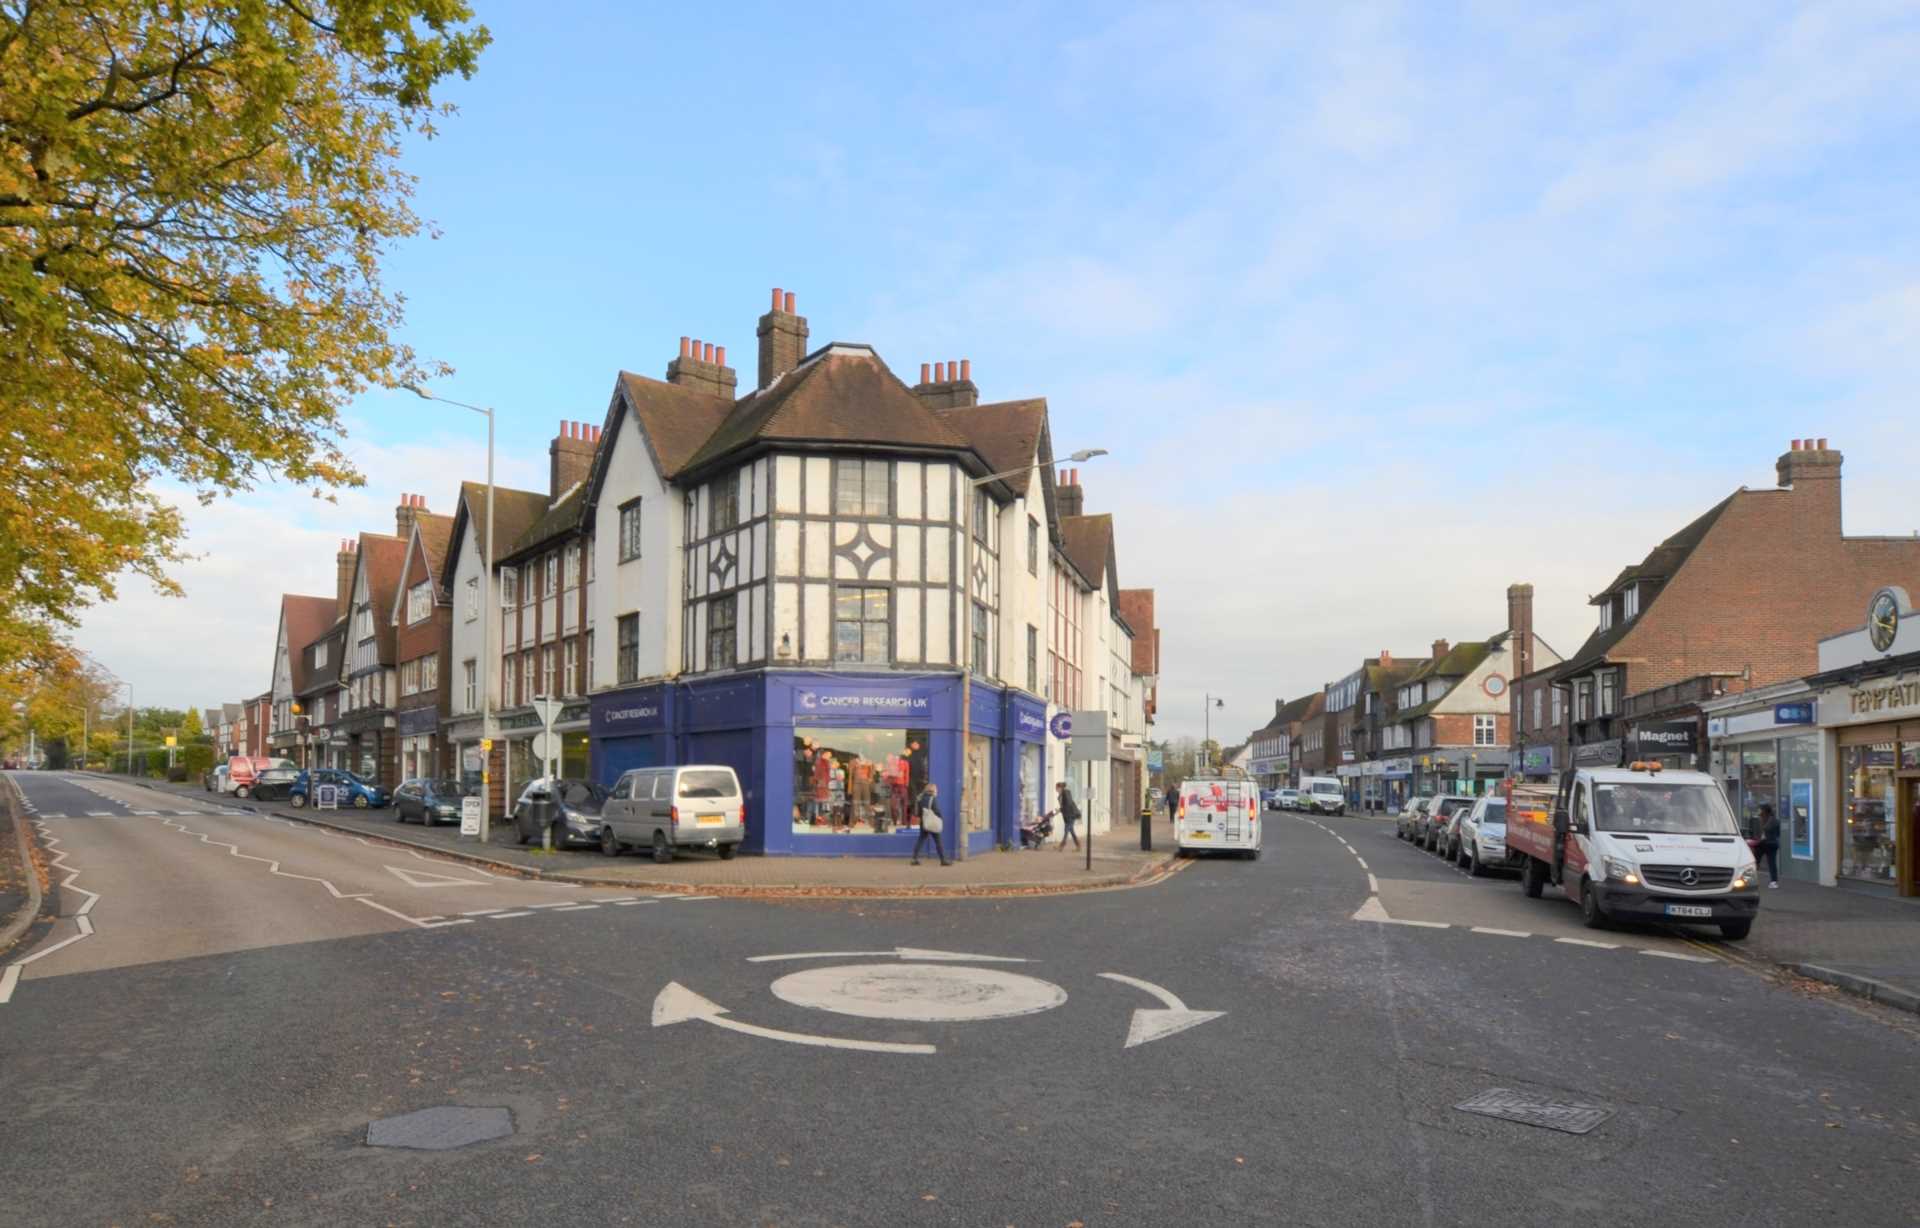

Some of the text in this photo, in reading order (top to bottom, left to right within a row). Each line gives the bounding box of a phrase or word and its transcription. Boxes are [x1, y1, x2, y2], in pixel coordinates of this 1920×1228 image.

[820, 696, 928, 708] CANCER RESEARCH UK
[1848, 682, 1920, 714] TEMPTATI
[1639, 731, 1689, 743] Magnet
